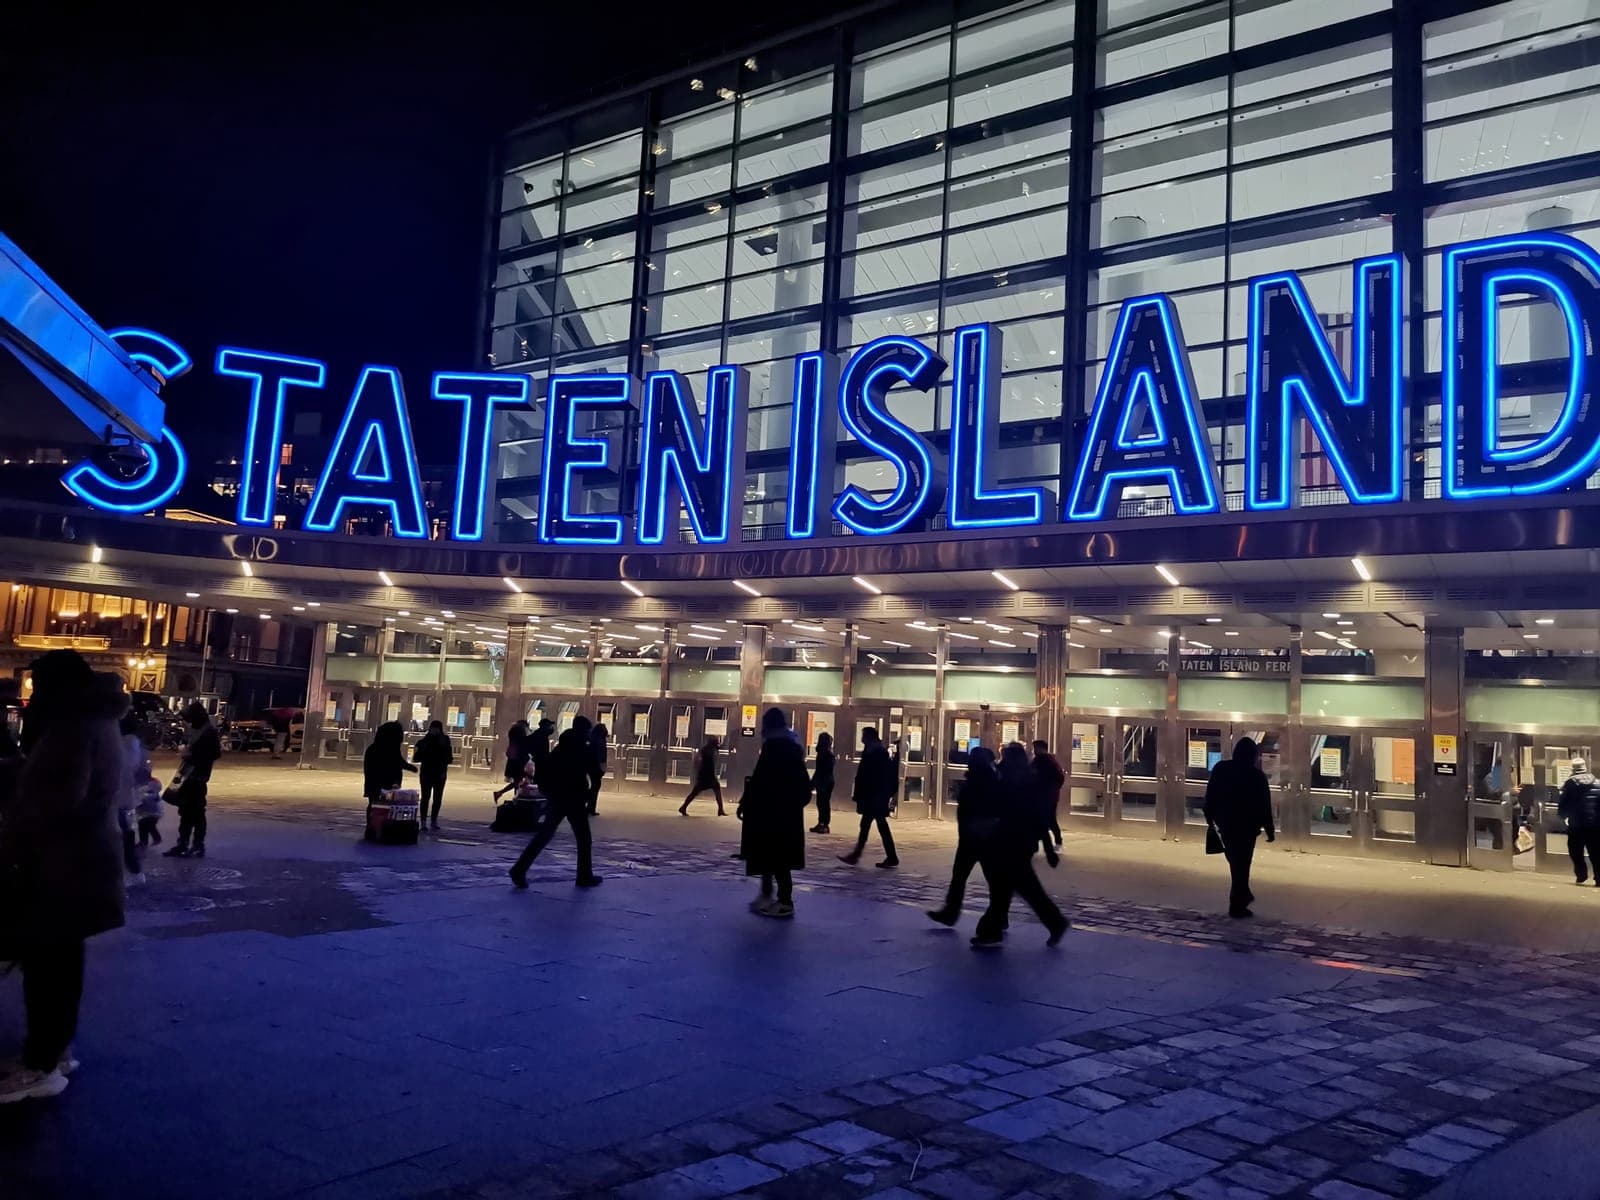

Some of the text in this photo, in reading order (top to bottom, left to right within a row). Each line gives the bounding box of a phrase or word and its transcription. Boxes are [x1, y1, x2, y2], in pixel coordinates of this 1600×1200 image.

[61, 231, 1600, 545] STATEN ISLAND
[1181, 660, 1291, 672] TATEN ISLAND FER
